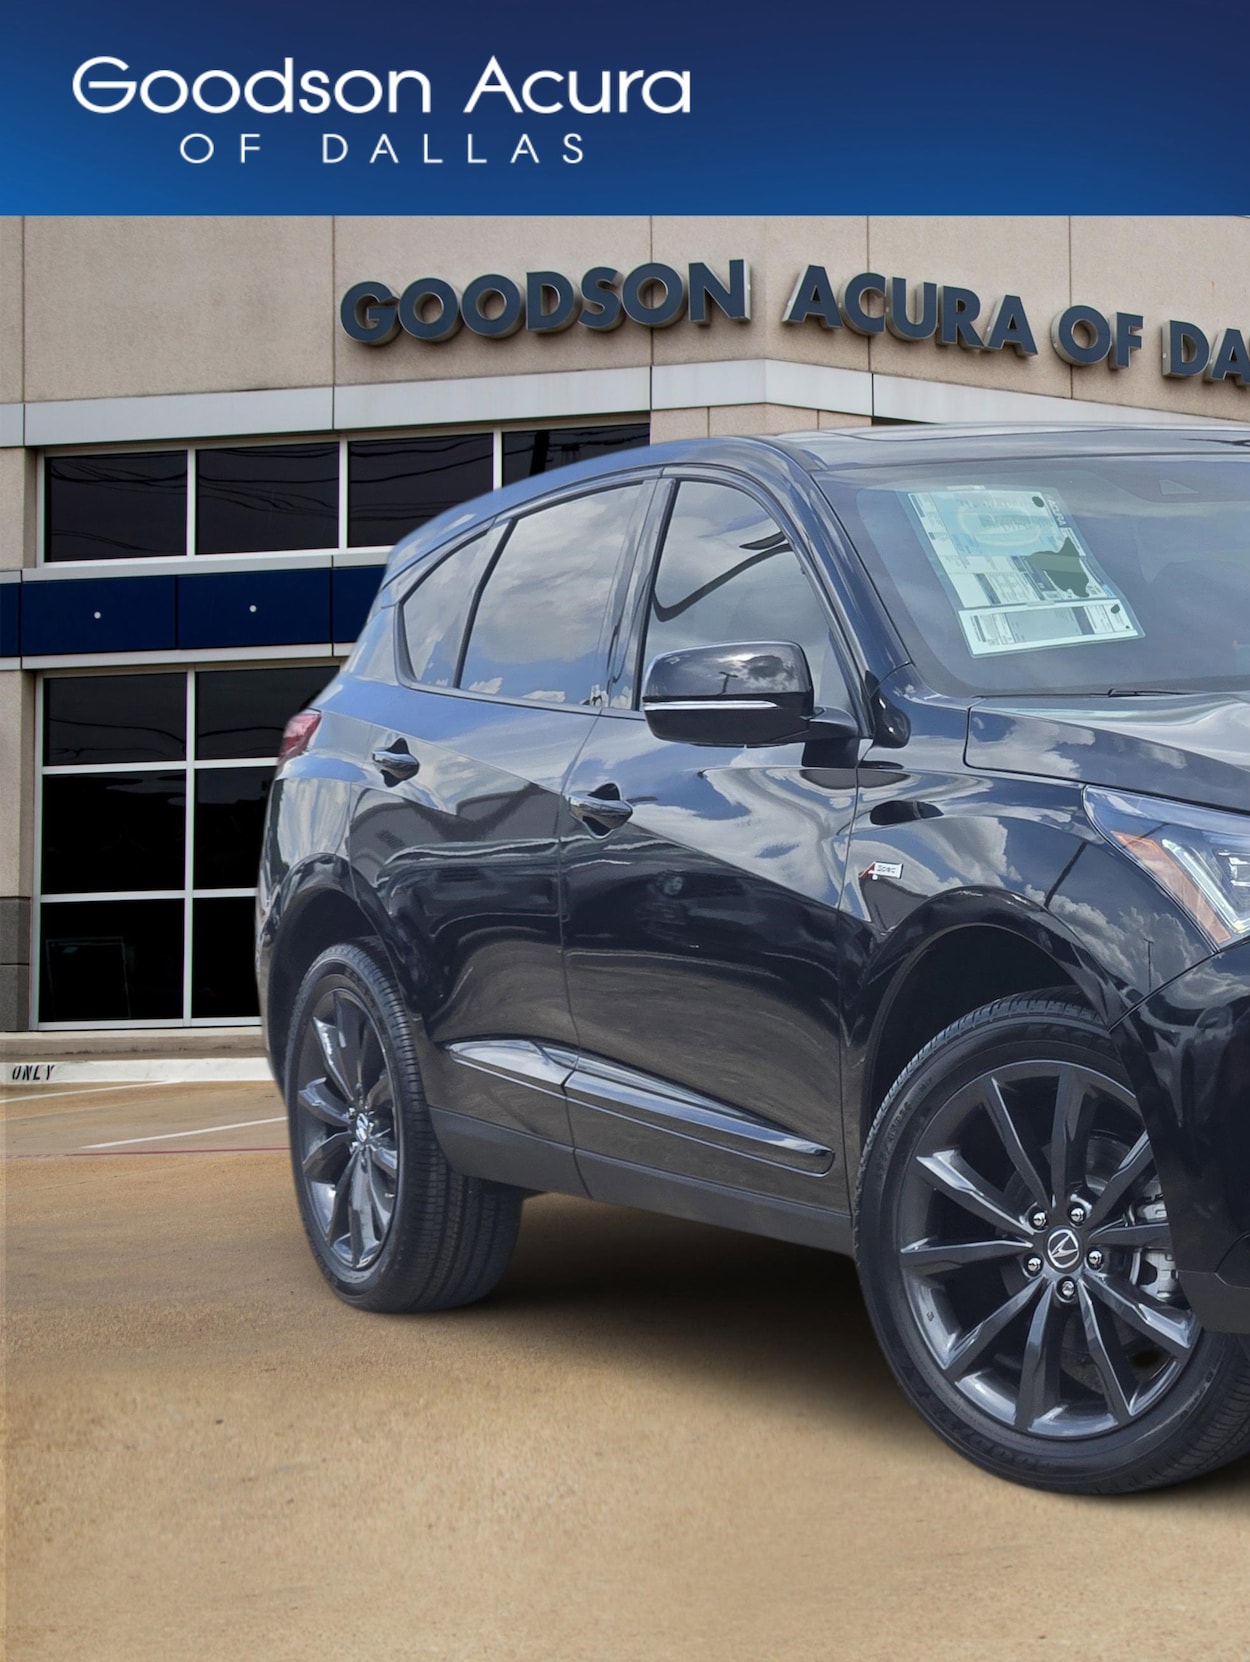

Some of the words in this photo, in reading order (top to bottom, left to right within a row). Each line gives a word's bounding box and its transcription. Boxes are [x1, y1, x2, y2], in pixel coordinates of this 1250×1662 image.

[340, 257, 752, 346] GOODSON
[781, 263, 1038, 357] ACURA
[1050, 304, 1144, 369] OF
[11, 1064, 56, 1081] ONLY
